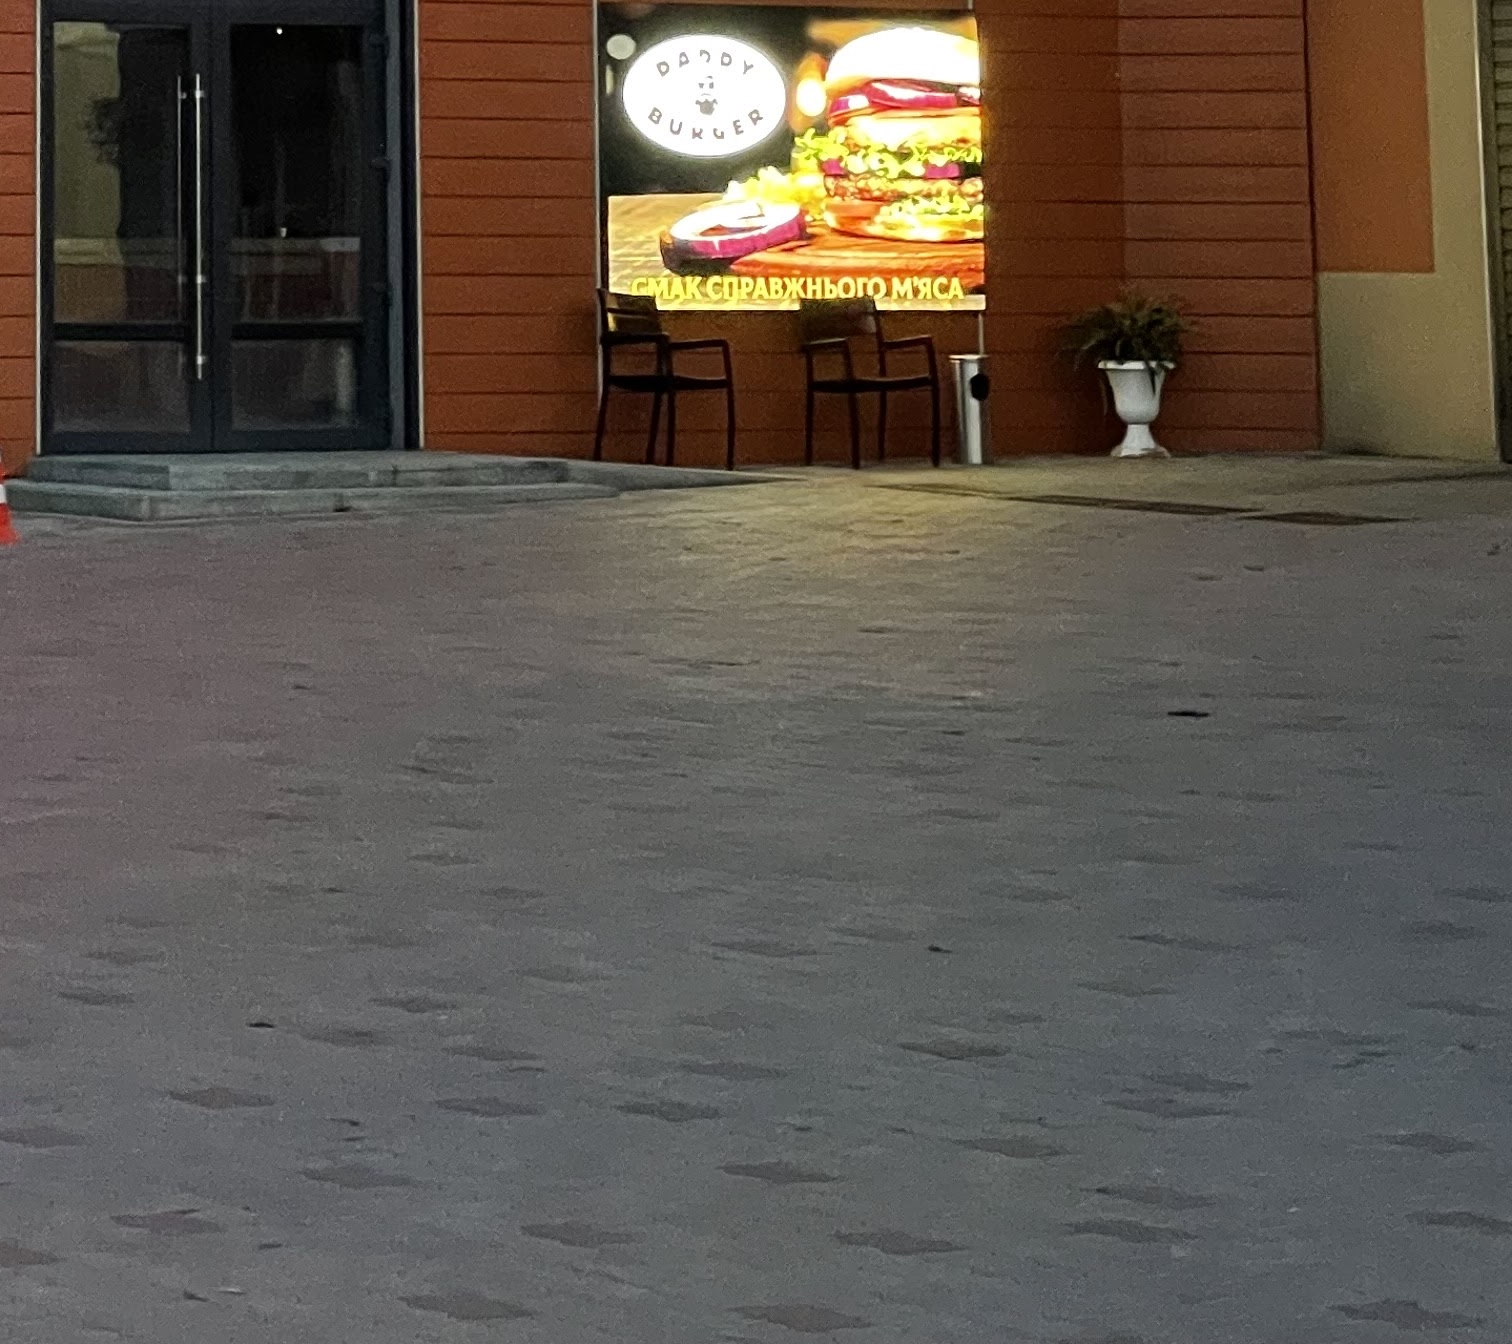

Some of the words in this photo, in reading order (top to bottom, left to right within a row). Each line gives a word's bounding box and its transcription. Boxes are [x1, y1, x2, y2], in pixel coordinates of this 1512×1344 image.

[648, 107, 763, 140] BURGER
[632, 277, 702, 299] СМАК
[705, 277, 886, 300] СПРАВЖНЬОГО
[892, 278, 965, 300] М'ЯСА
